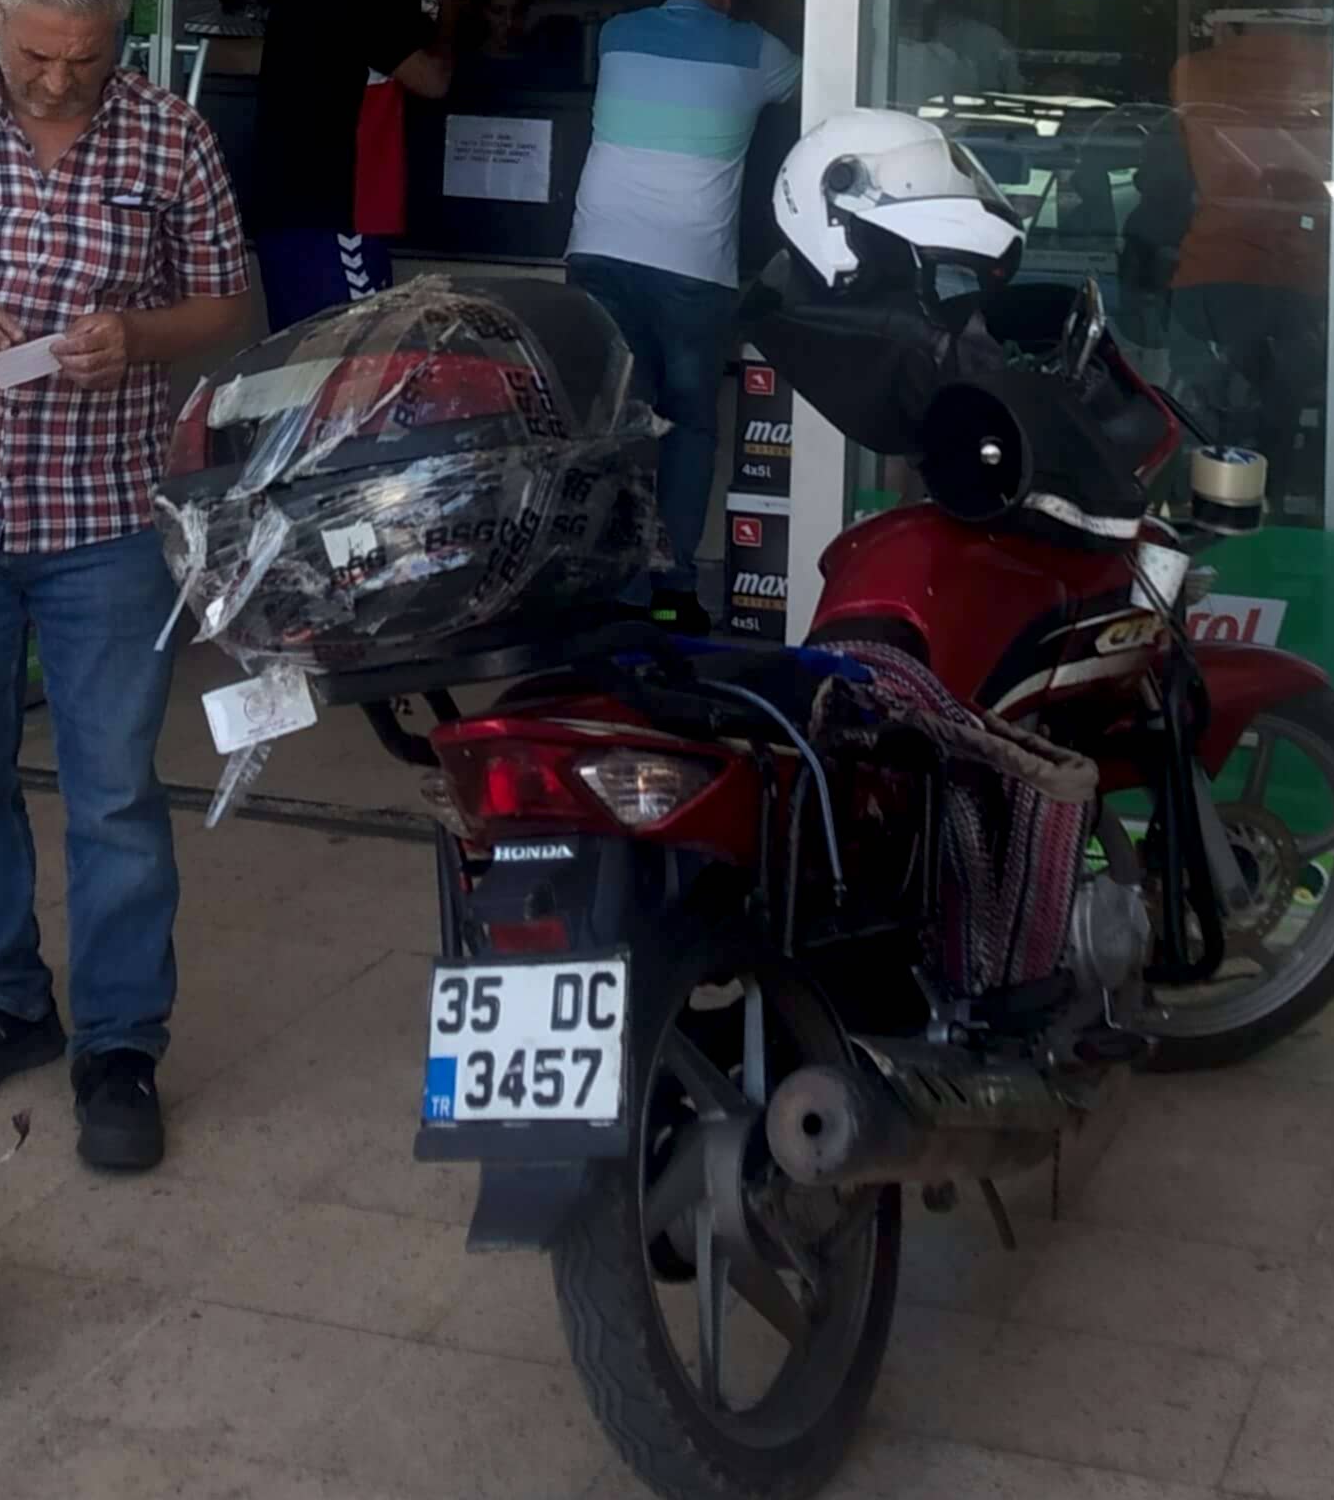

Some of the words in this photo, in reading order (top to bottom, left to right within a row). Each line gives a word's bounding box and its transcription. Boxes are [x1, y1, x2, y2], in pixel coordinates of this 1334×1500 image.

[493, 845, 574, 862] HONDA
[436, 975, 504, 1035] 35
[550, 970, 617, 1032] DC
[430, 1097, 450, 1117] TR
[464, 1047, 603, 1110] 3457
